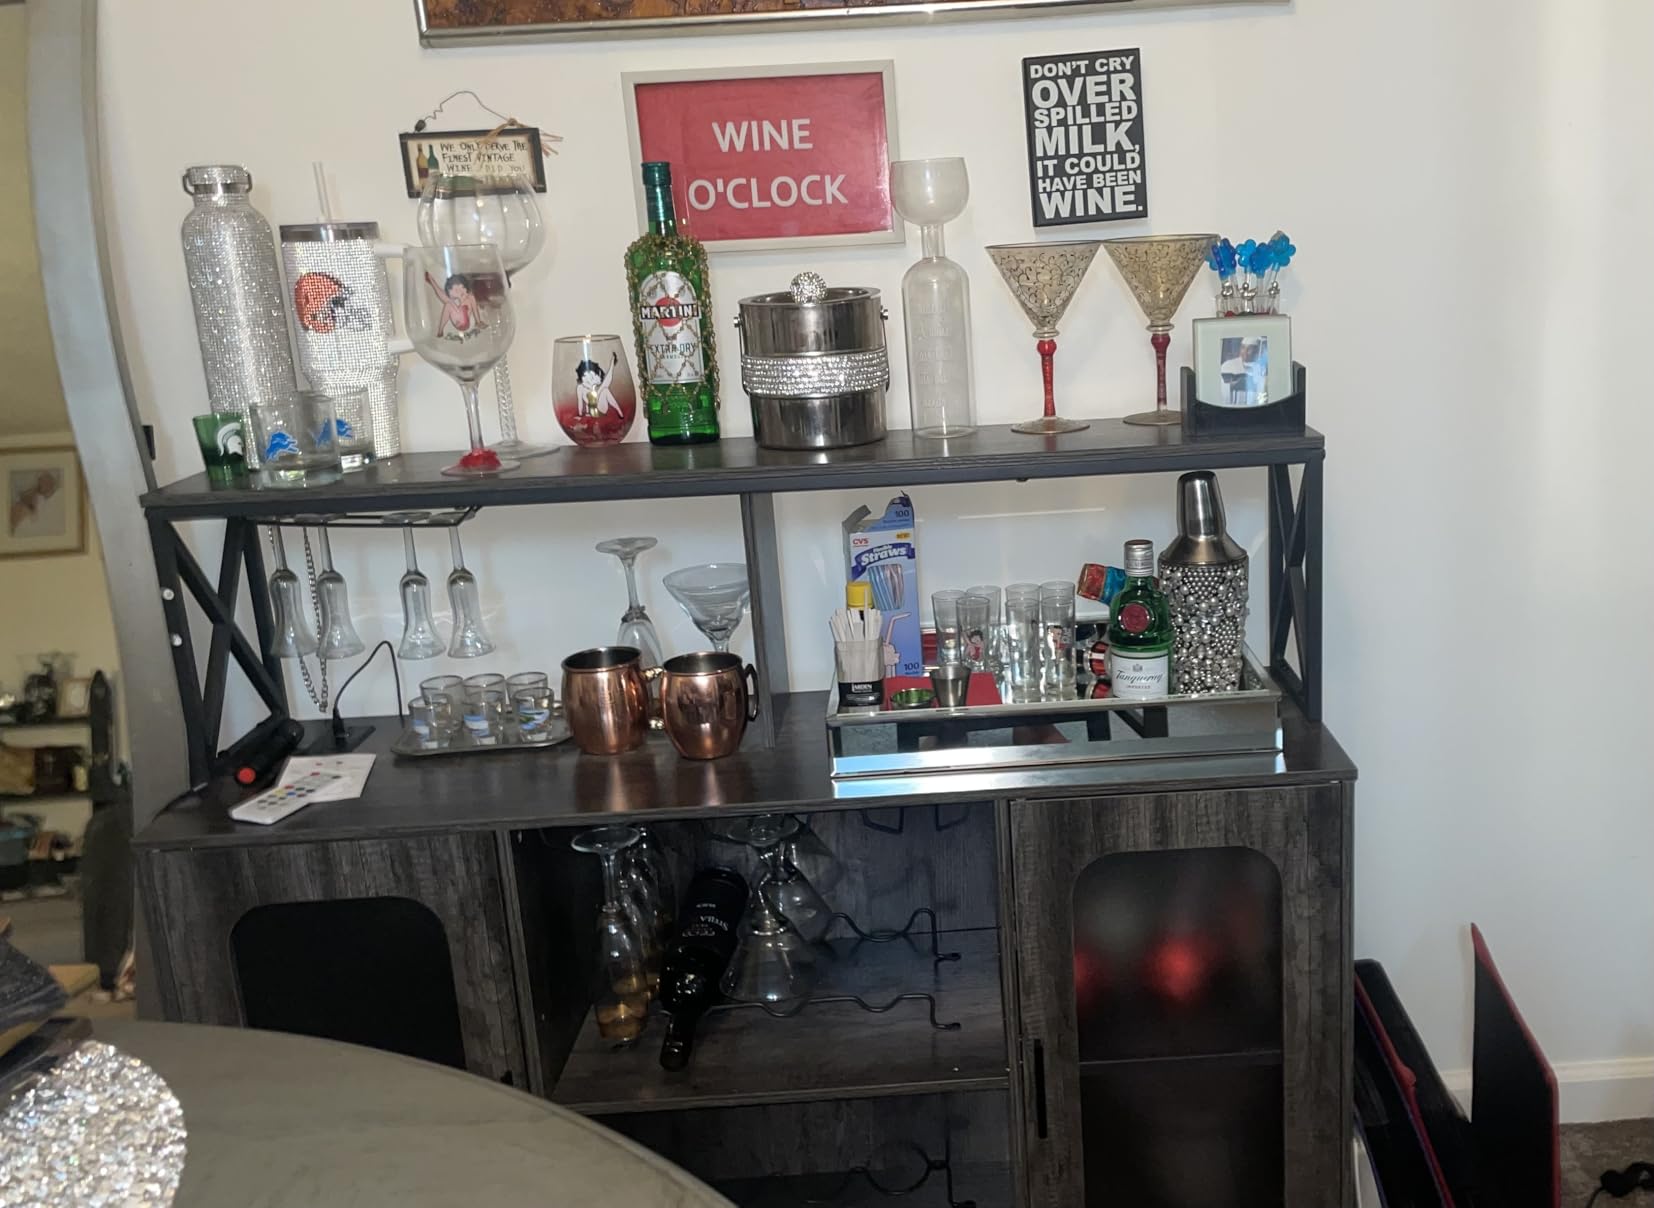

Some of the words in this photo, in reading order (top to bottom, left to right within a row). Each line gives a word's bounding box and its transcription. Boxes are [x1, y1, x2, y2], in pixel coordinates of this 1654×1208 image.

[1030, 60, 1089, 78] DON'T
[1095, 56, 1135, 72] CRY
[1032, 72, 1137, 109] OVER
[1034, 101, 1138, 128] SPILLED
[440, 143, 456, 152] WE
[712, 118, 813, 152] WINE
[1035, 121, 1140, 157] MILK,
[1037, 159, 1058, 177] IT
[1064, 152, 1141, 175] COULD
[688, 174, 848, 210] O'CLOCK
[1038, 175, 1087, 193] HAVE
[1092, 170, 1141, 188] BEEN
[1039, 185, 1143, 219] WINE.
[861, 547, 906, 566] Straws
[904, 662, 920, 671] 100
